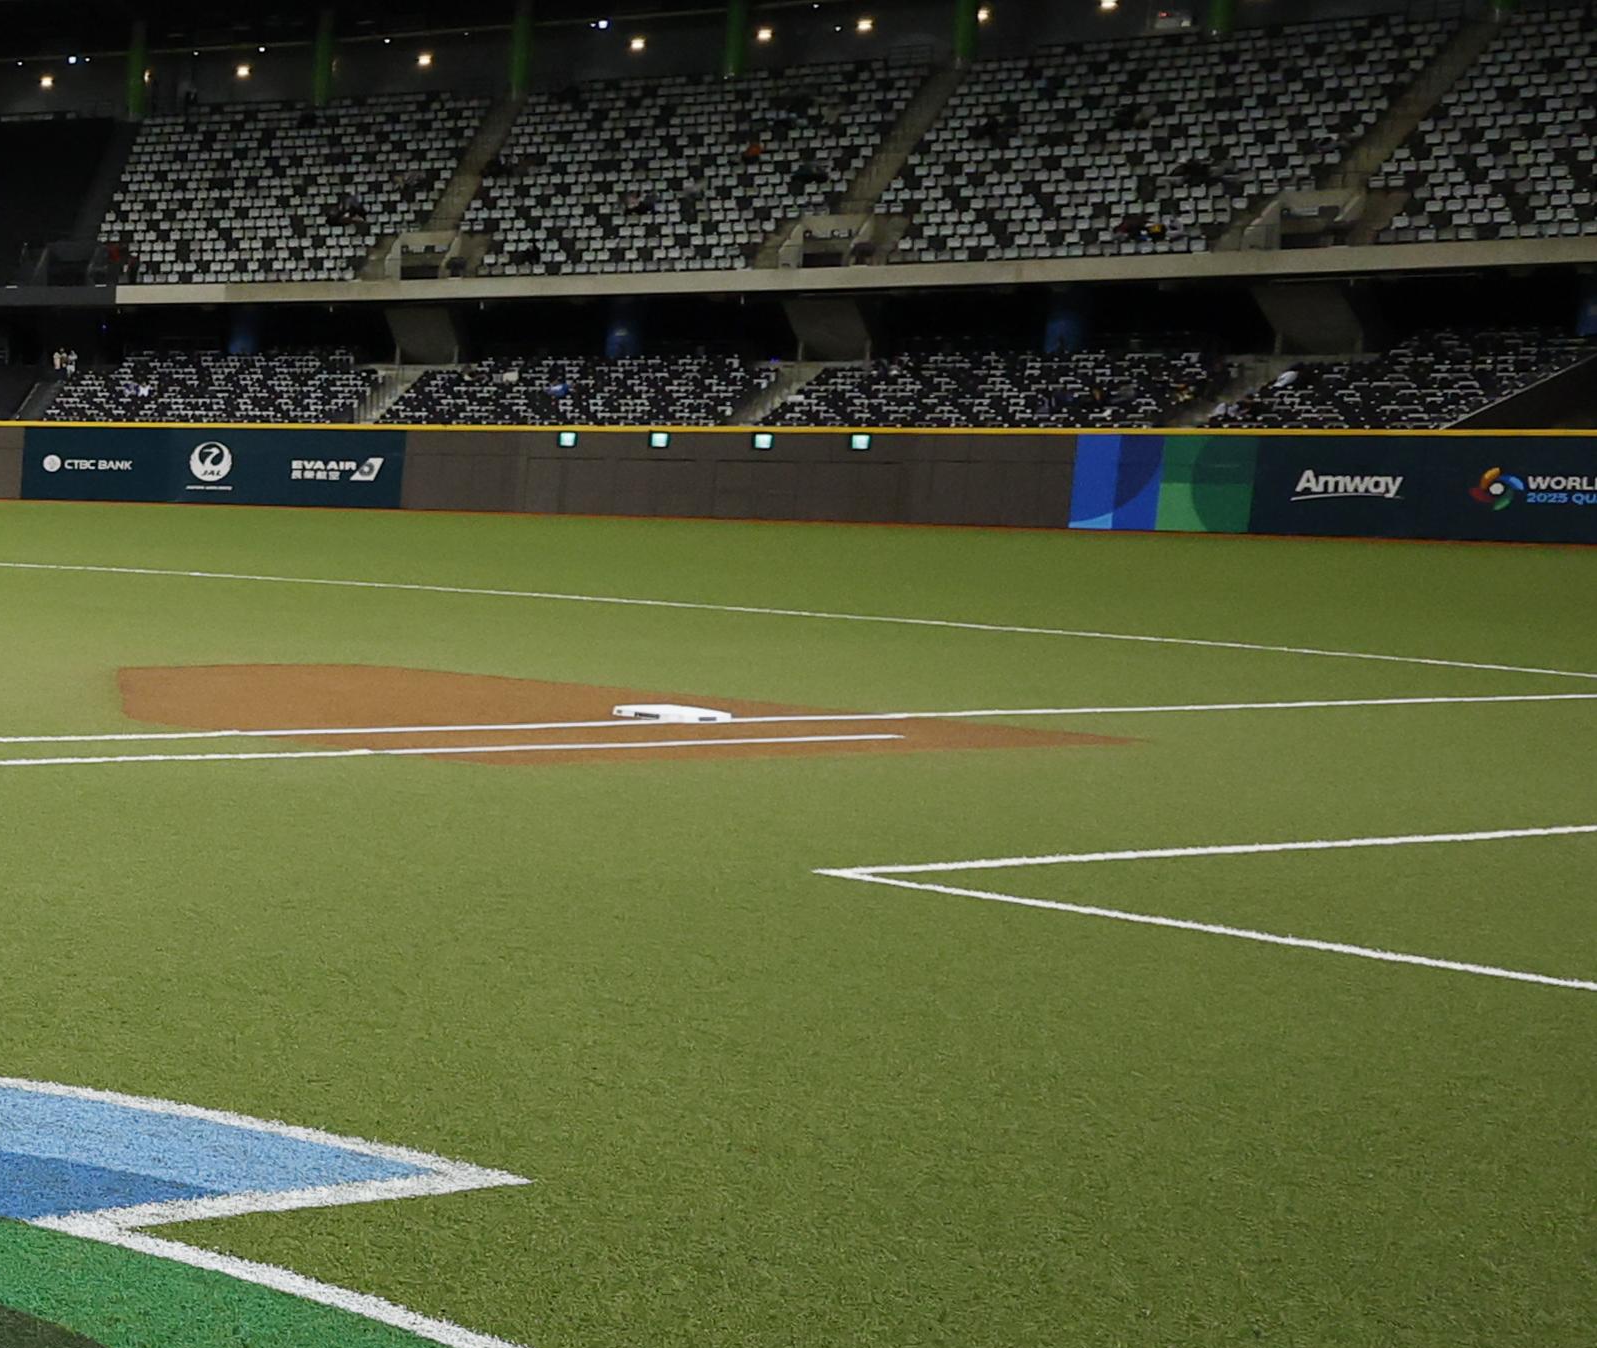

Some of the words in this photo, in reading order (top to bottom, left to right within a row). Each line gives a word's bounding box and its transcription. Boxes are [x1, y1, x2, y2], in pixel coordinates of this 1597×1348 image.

[64, 459, 97, 470] CTBC
[98, 460, 133, 471] BANK
[291, 459, 325, 470] EVA
[326, 460, 357, 471] AIR
[200, 469, 222, 477] JAL
[1295, 469, 1404, 498] Amway
[1527, 476, 1597, 491] WORL
[1527, 492, 1568, 504] 2025
